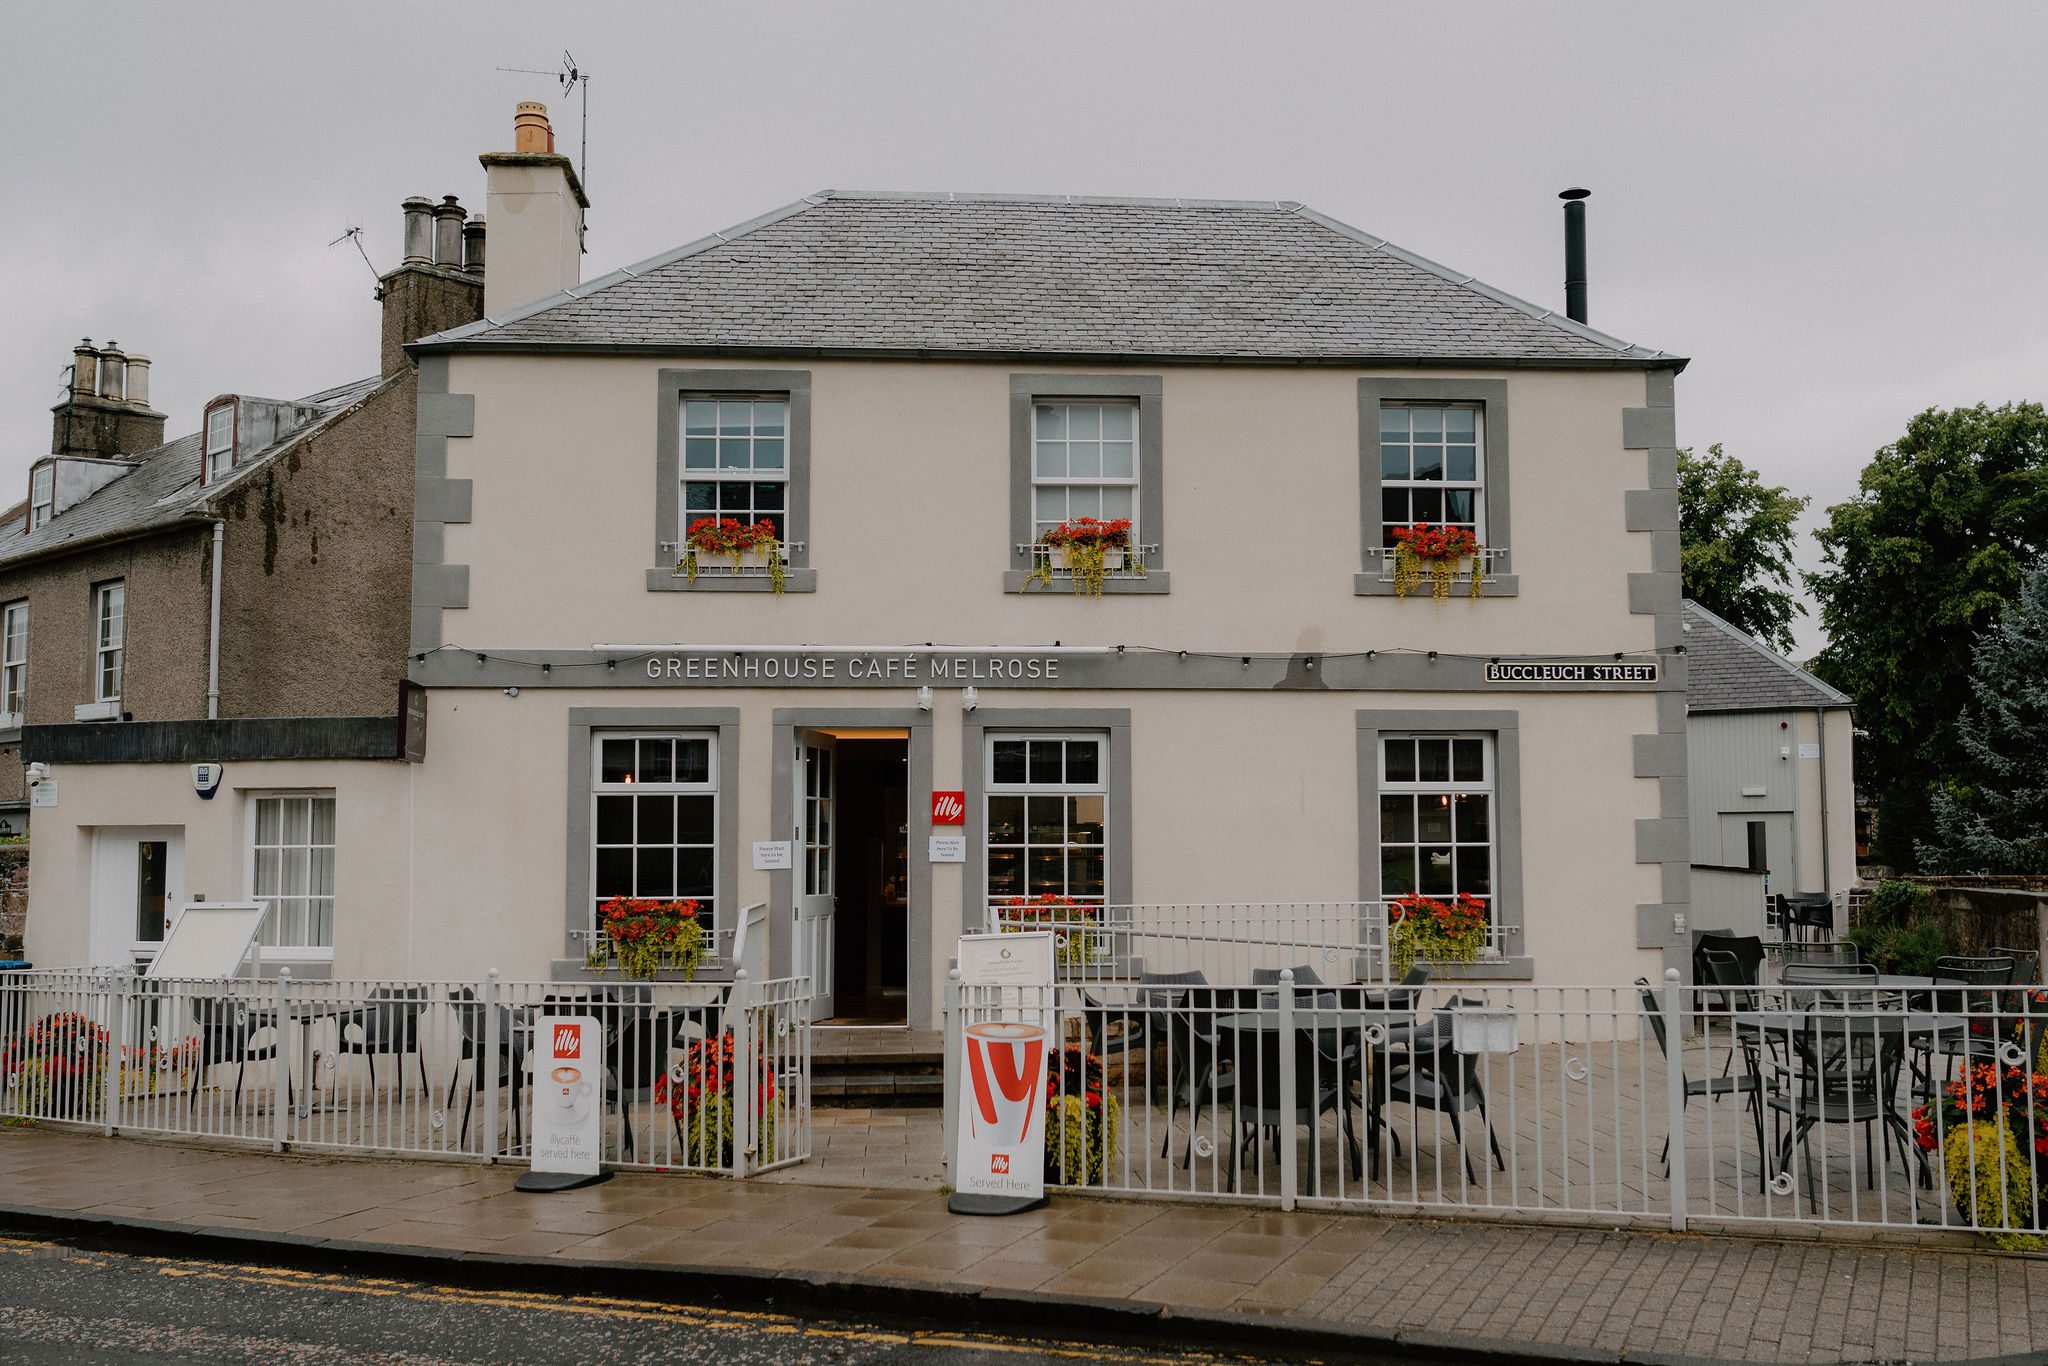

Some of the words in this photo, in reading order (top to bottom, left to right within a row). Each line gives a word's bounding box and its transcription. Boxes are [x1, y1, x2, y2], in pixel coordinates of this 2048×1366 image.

[646, 657, 836, 678] GREENHOUSE
[848, 653, 918, 679] CAFÉ
[931, 658, 1059, 679] MELROSE
[1490, 666, 1585, 680] BUCCLEUCH
[1593, 666, 1653, 680] STREET
[934, 795, 963, 821] illy
[167, 891, 173, 902] 4
[554, 1028, 580, 1057] illy
[540, 1147, 569, 1160] served
[571, 1148, 590, 1160] here
[992, 1155, 1009, 1173] illy
[969, 1176, 1003, 1189] Served
[1006, 1178, 1031, 1191] Here
